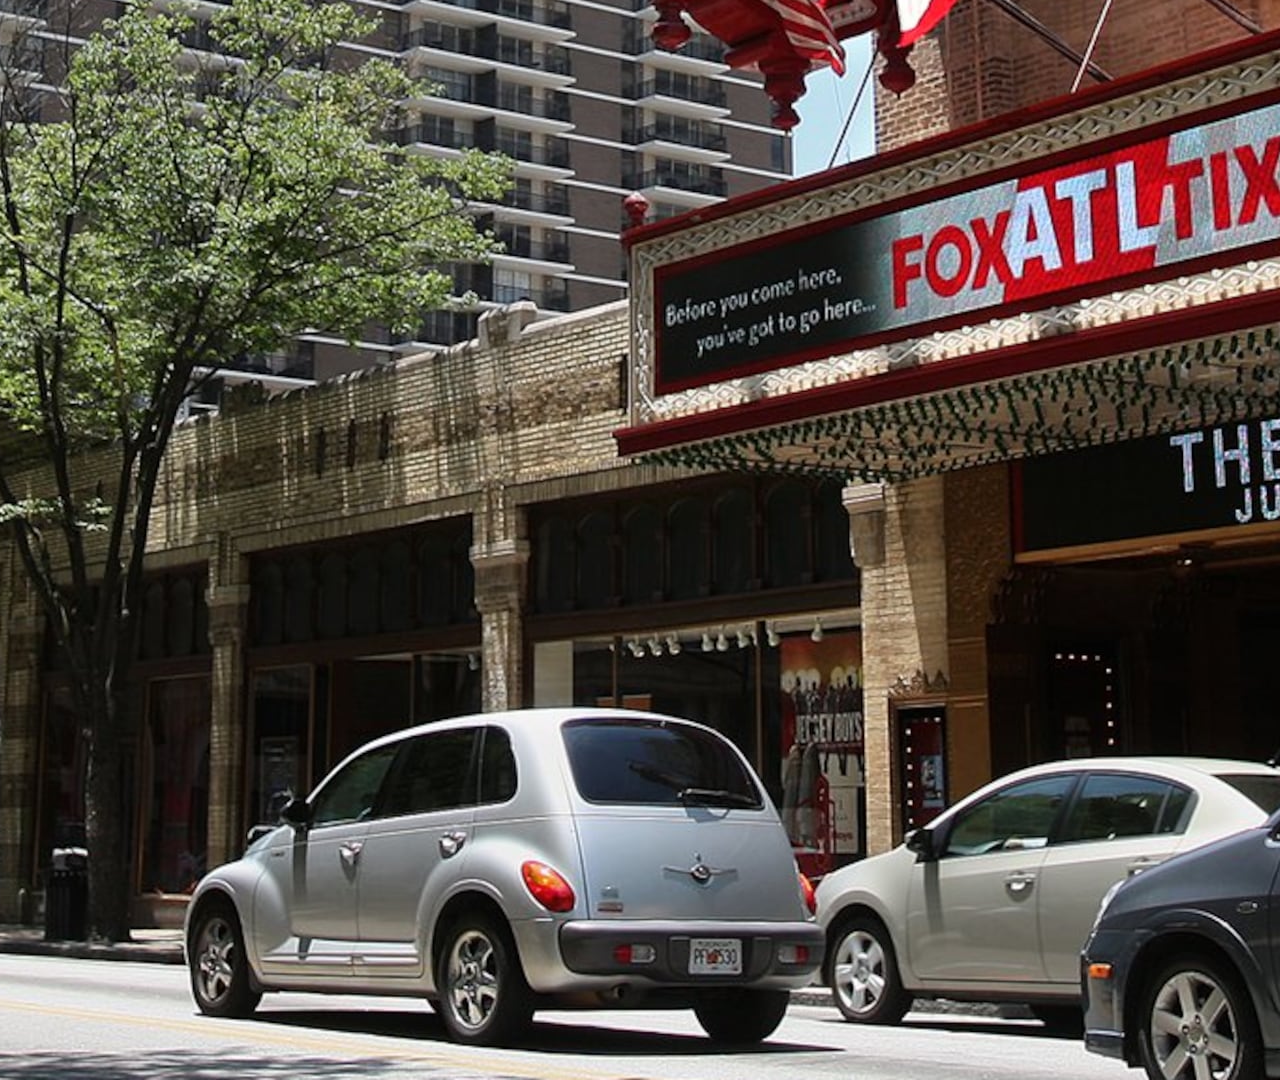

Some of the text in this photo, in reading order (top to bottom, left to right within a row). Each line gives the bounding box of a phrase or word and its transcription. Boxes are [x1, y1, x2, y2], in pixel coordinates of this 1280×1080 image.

[665, 297, 717, 328] Before
[719, 291, 749, 319] you
[750, 277, 796, 305] come
[696, 321, 746, 358] you've
[747, 315, 775, 347] got
[778, 312, 797, 333] to
[799, 310, 821, 335] go
[833, 710, 863, 742] BOYS
